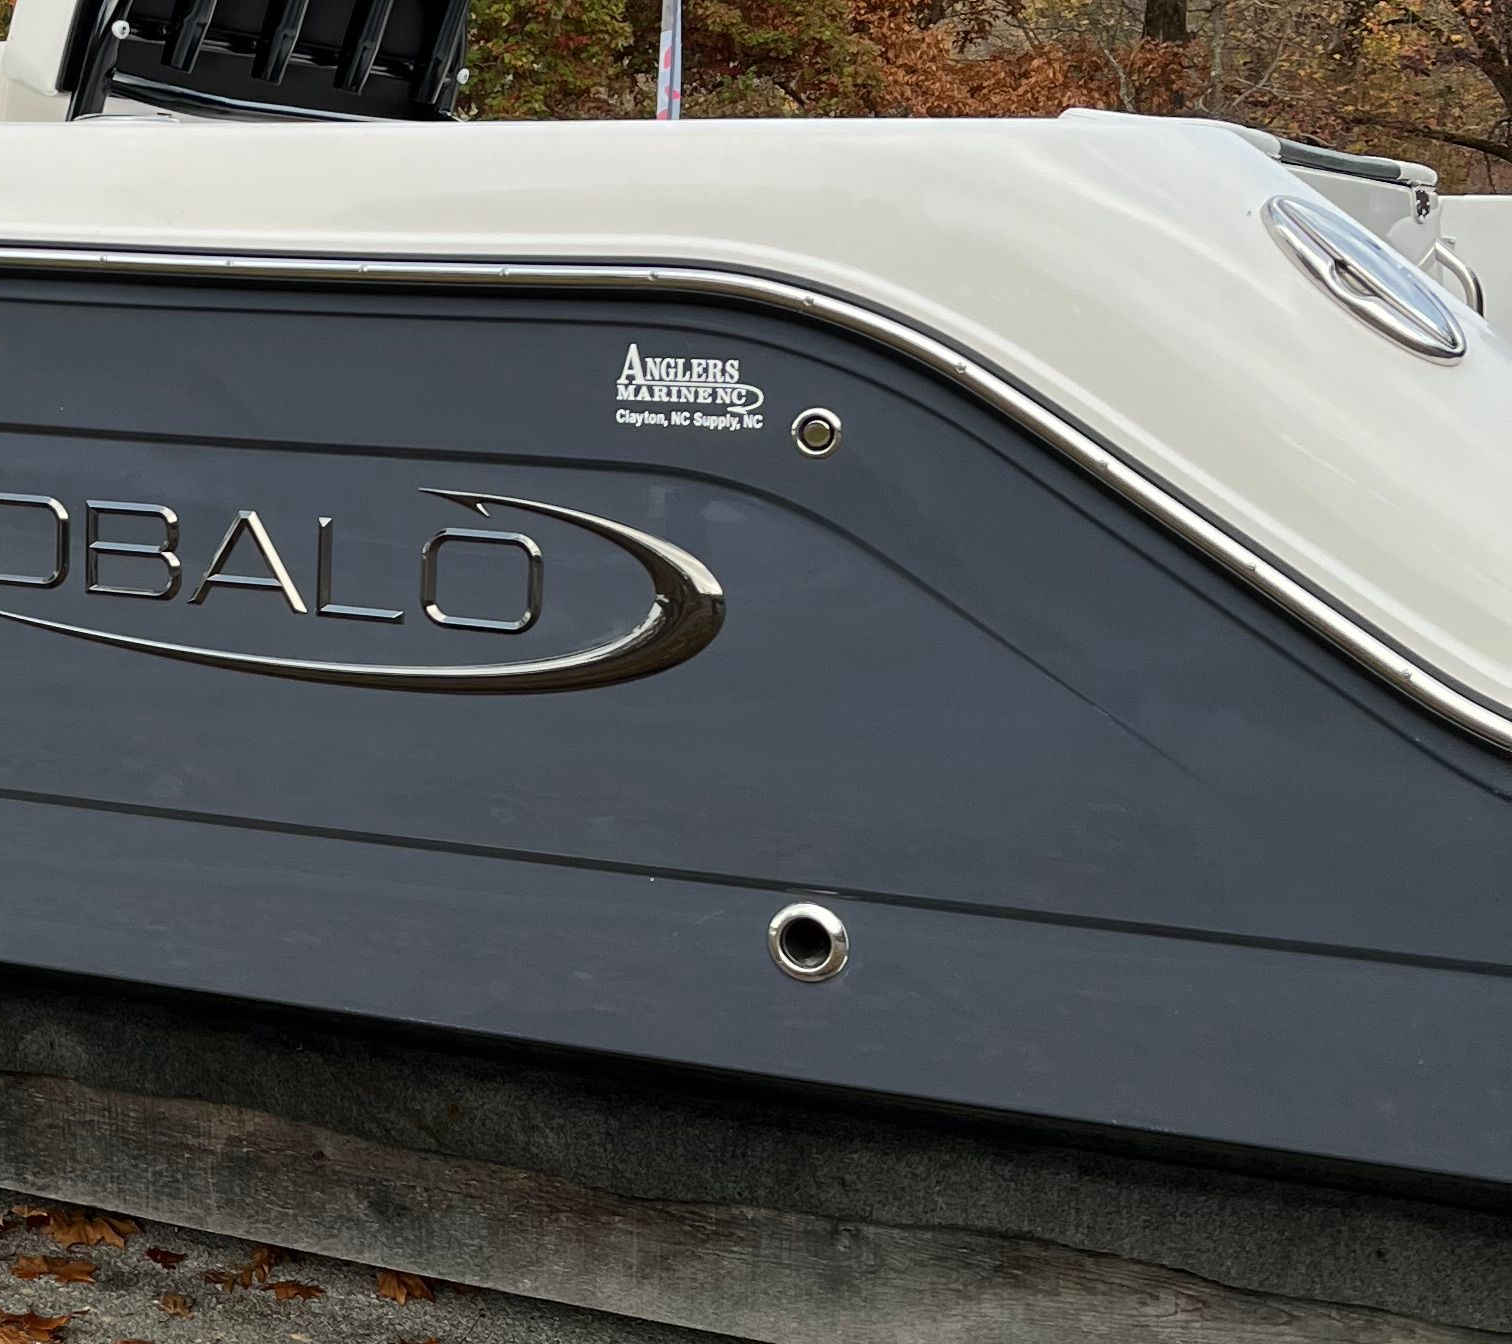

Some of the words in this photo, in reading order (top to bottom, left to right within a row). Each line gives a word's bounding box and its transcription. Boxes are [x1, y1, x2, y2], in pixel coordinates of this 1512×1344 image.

[616, 343, 739, 384] ANGLERS
[616, 385, 712, 402] MARINE
[715, 388, 746, 404] NC
[615, 408, 669, 427] Clayton,
[670, 411, 691, 426] NC
[742, 414, 764, 429] NC
